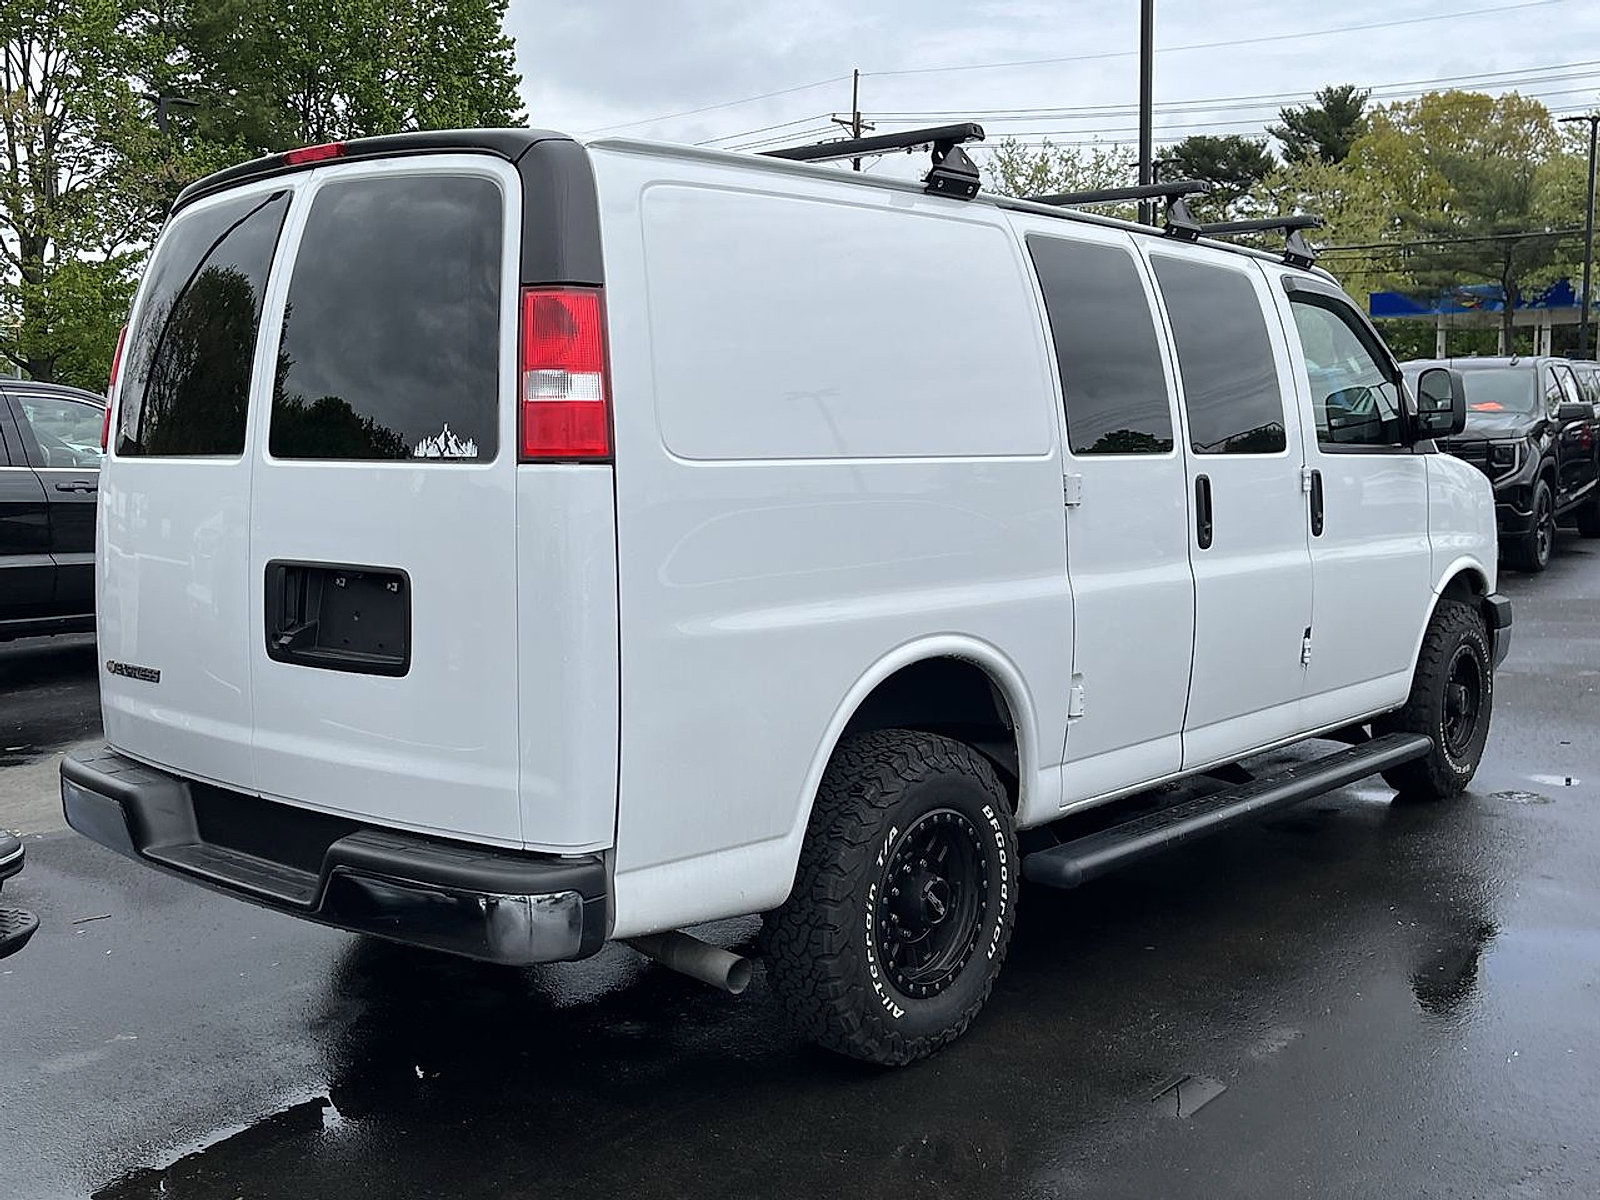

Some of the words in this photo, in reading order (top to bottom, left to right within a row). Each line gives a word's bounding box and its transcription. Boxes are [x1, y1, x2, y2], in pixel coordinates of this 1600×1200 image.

[876, 826, 898, 867] T/A
[982, 804, 1007, 960] BFGoodrich
[865, 883, 905, 1019] All-Terrain
